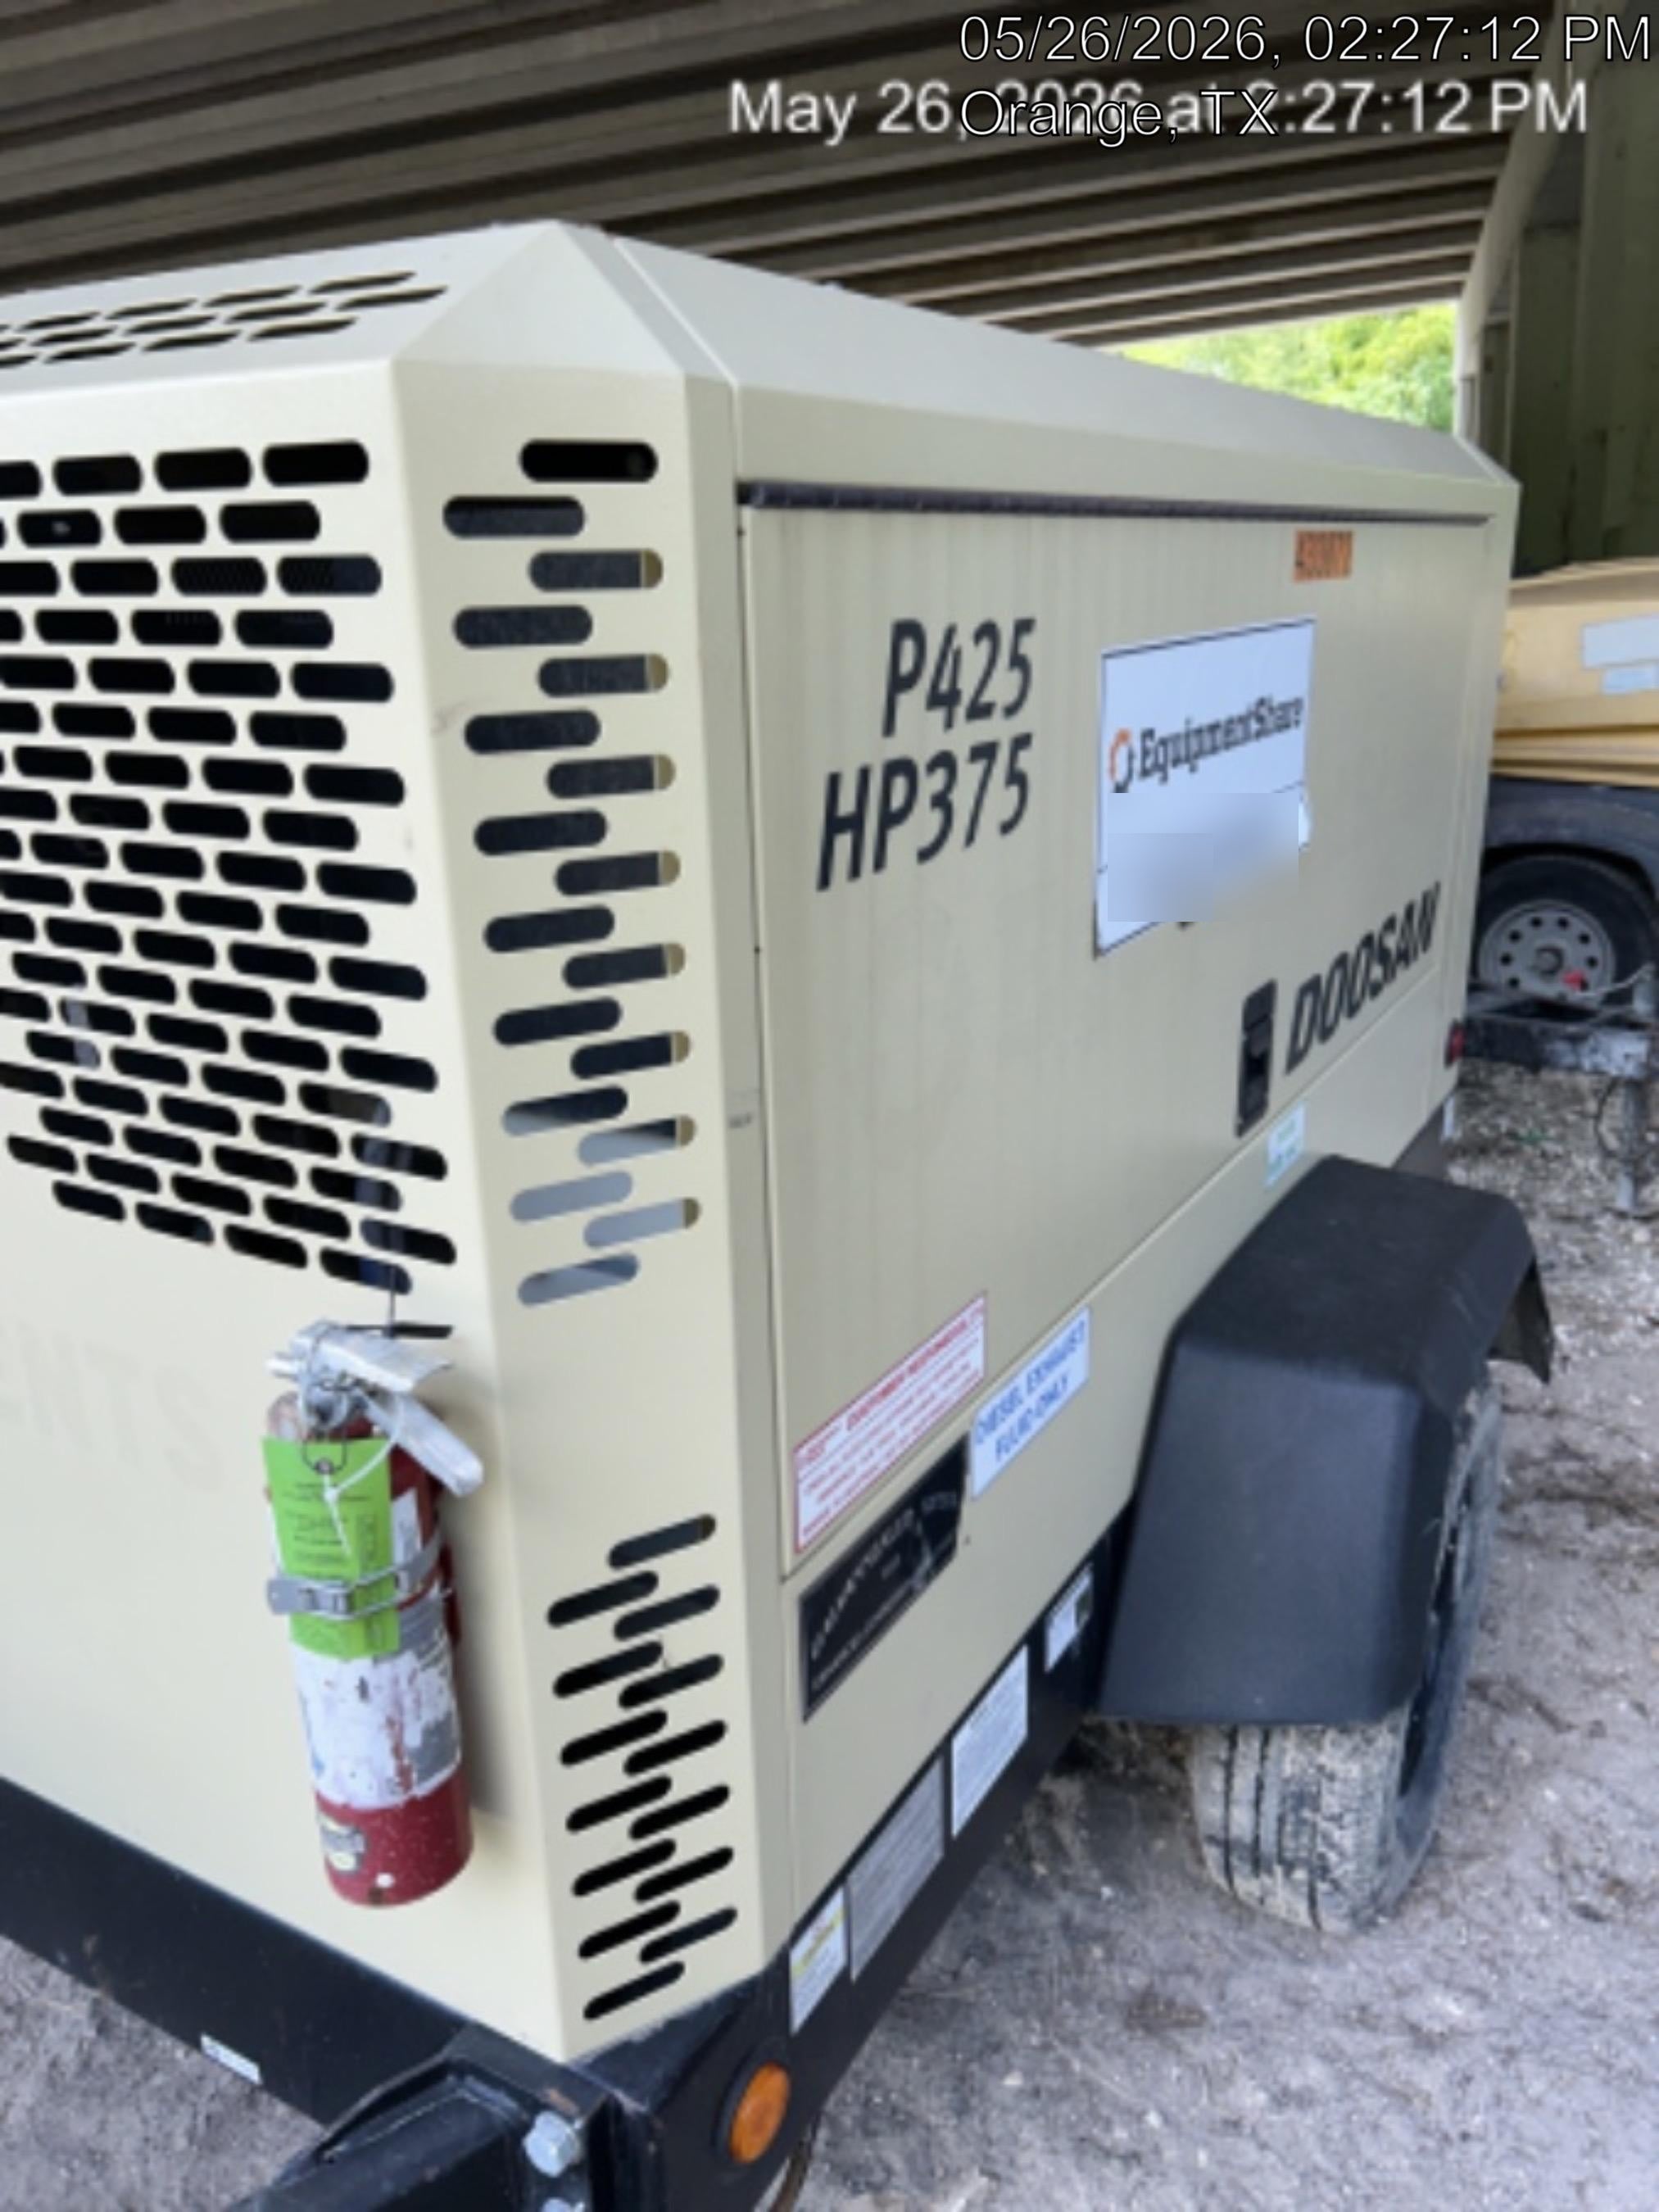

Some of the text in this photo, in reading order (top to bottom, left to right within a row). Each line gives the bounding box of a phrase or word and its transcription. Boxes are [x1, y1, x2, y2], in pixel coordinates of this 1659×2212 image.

[882, 618, 1036, 737] P425
[1139, 696, 1304, 783] EquipmentShare
[817, 734, 1033, 891] HP375
[1284, 882, 1441, 1075] DOOSAN
